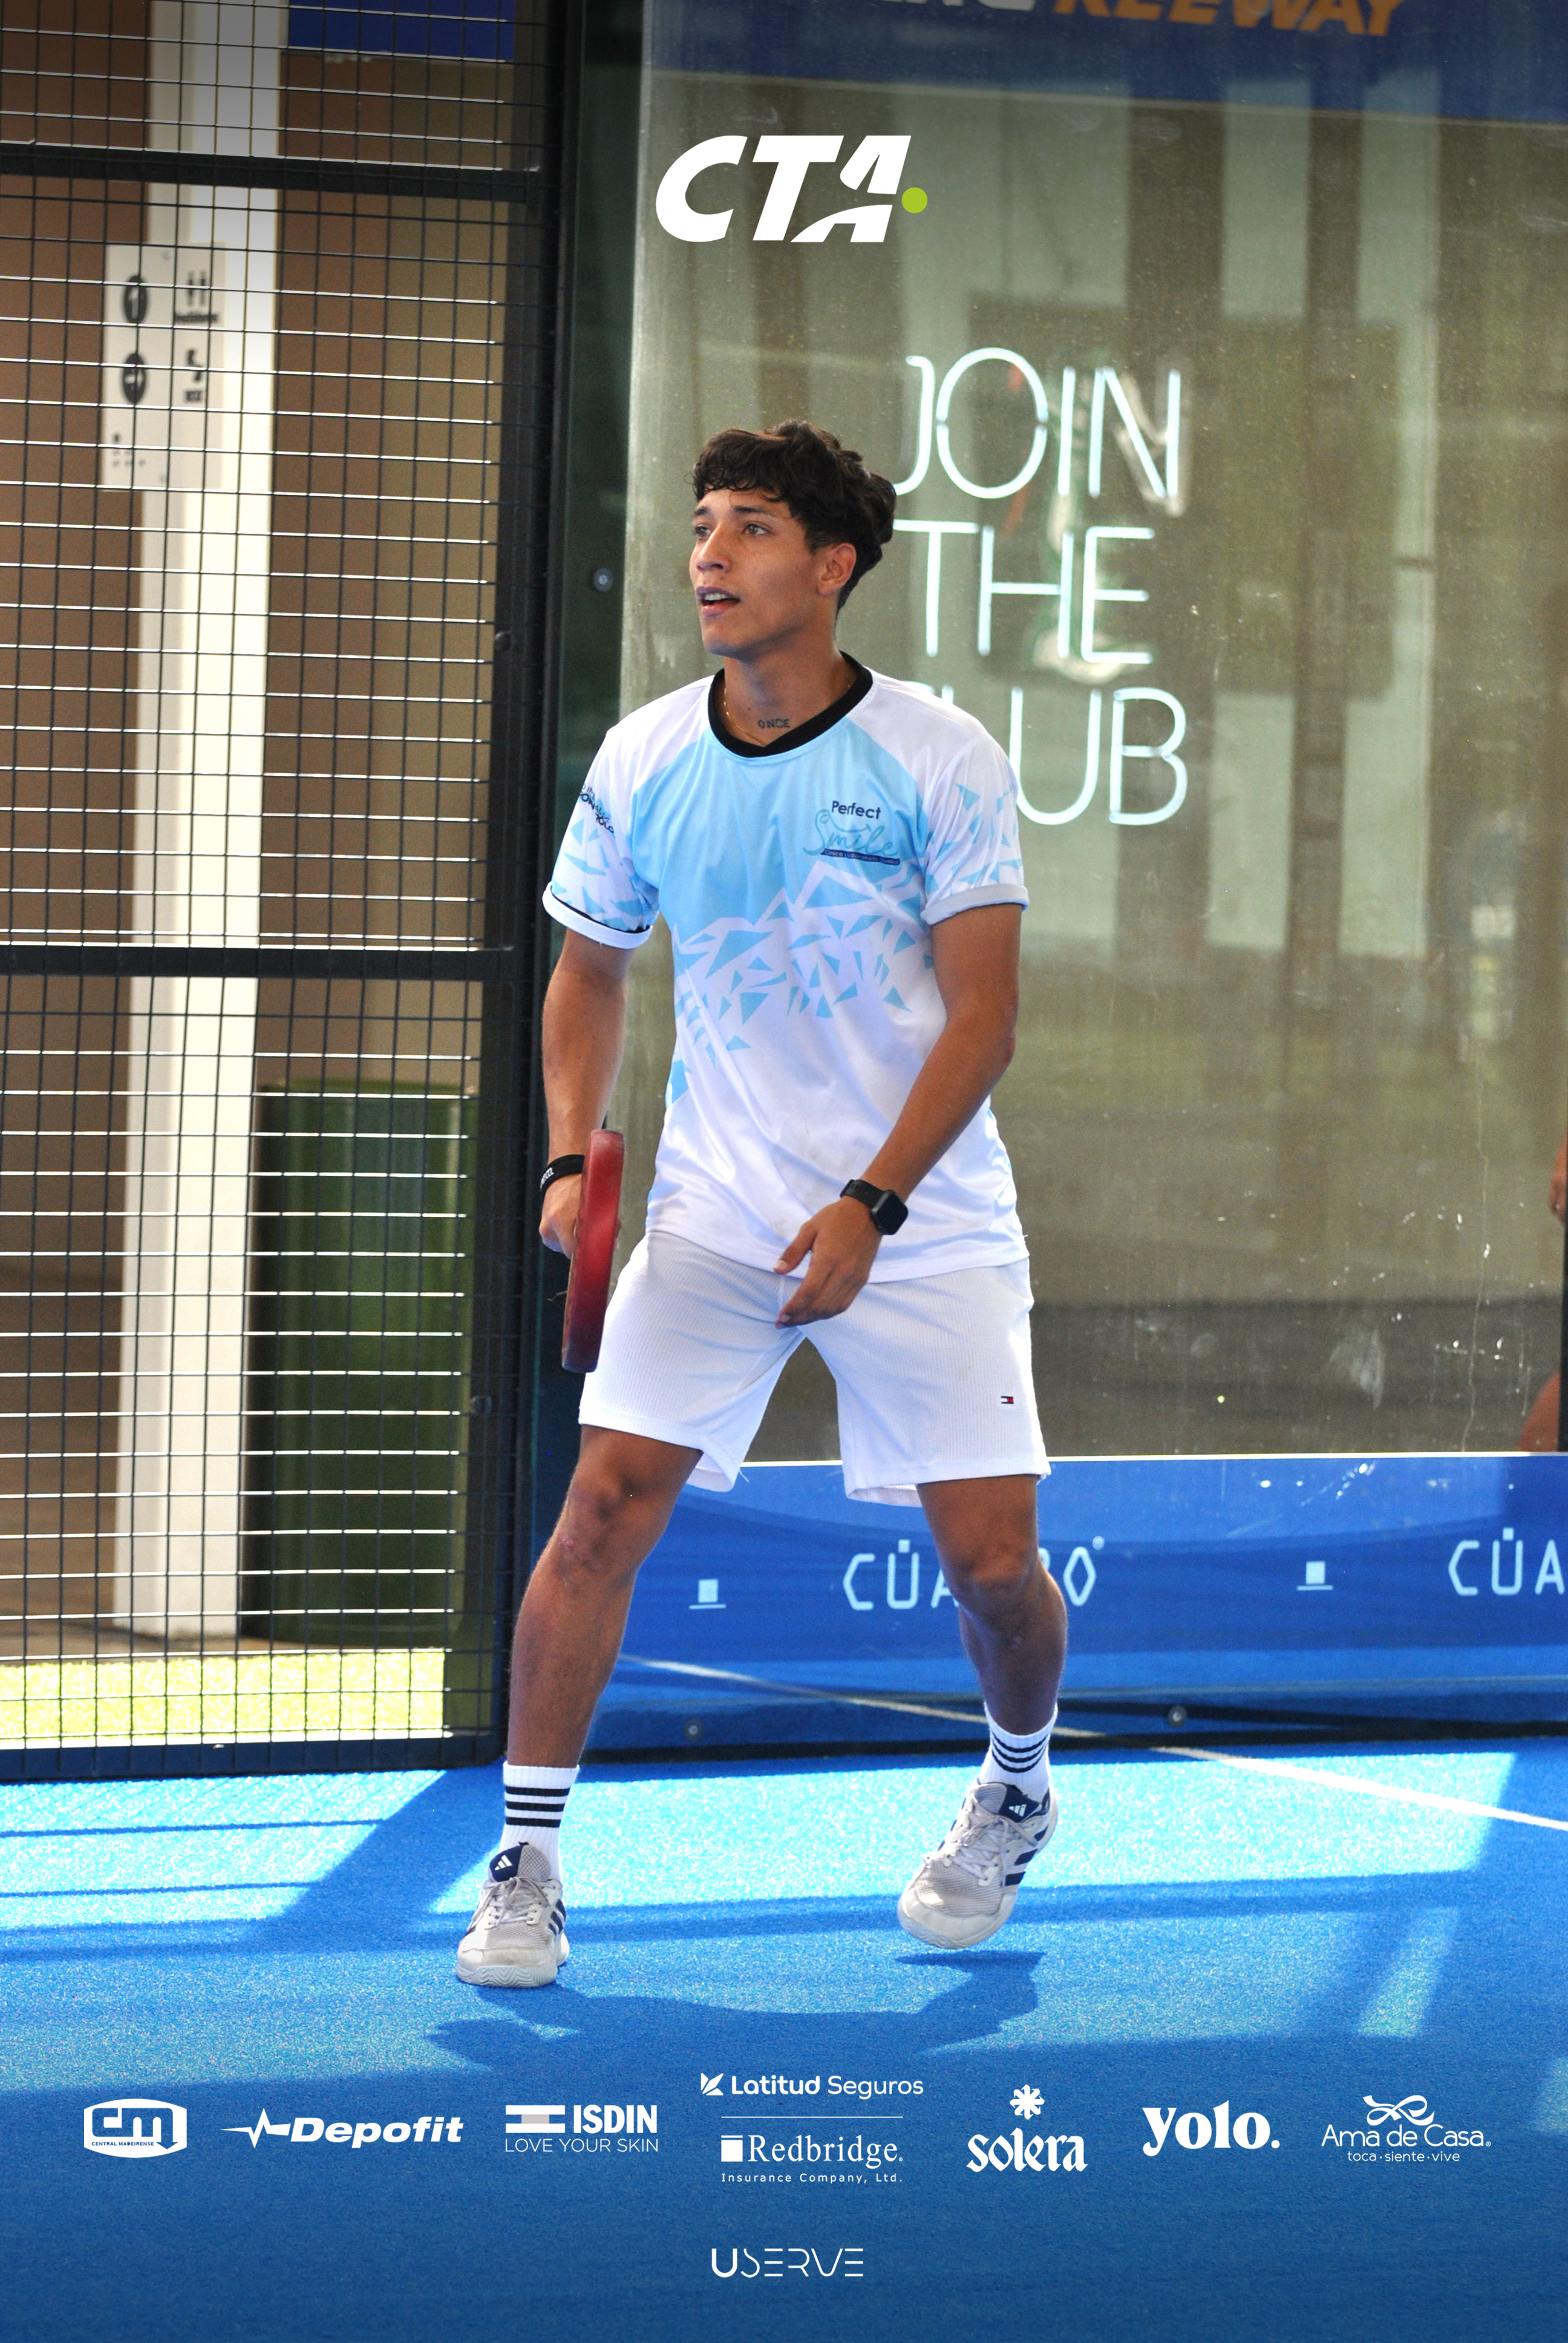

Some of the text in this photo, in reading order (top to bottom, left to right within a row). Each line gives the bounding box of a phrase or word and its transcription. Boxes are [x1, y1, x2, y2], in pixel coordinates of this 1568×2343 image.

[895, 347, 1181, 499] JOIN
[893, 519, 1154, 664] THE
[757, 718, 790, 729] ONCE
[903, 681, 1187, 825] UB
[803, 809, 900, 856] Smile
[831, 800, 881, 819] Perfect
